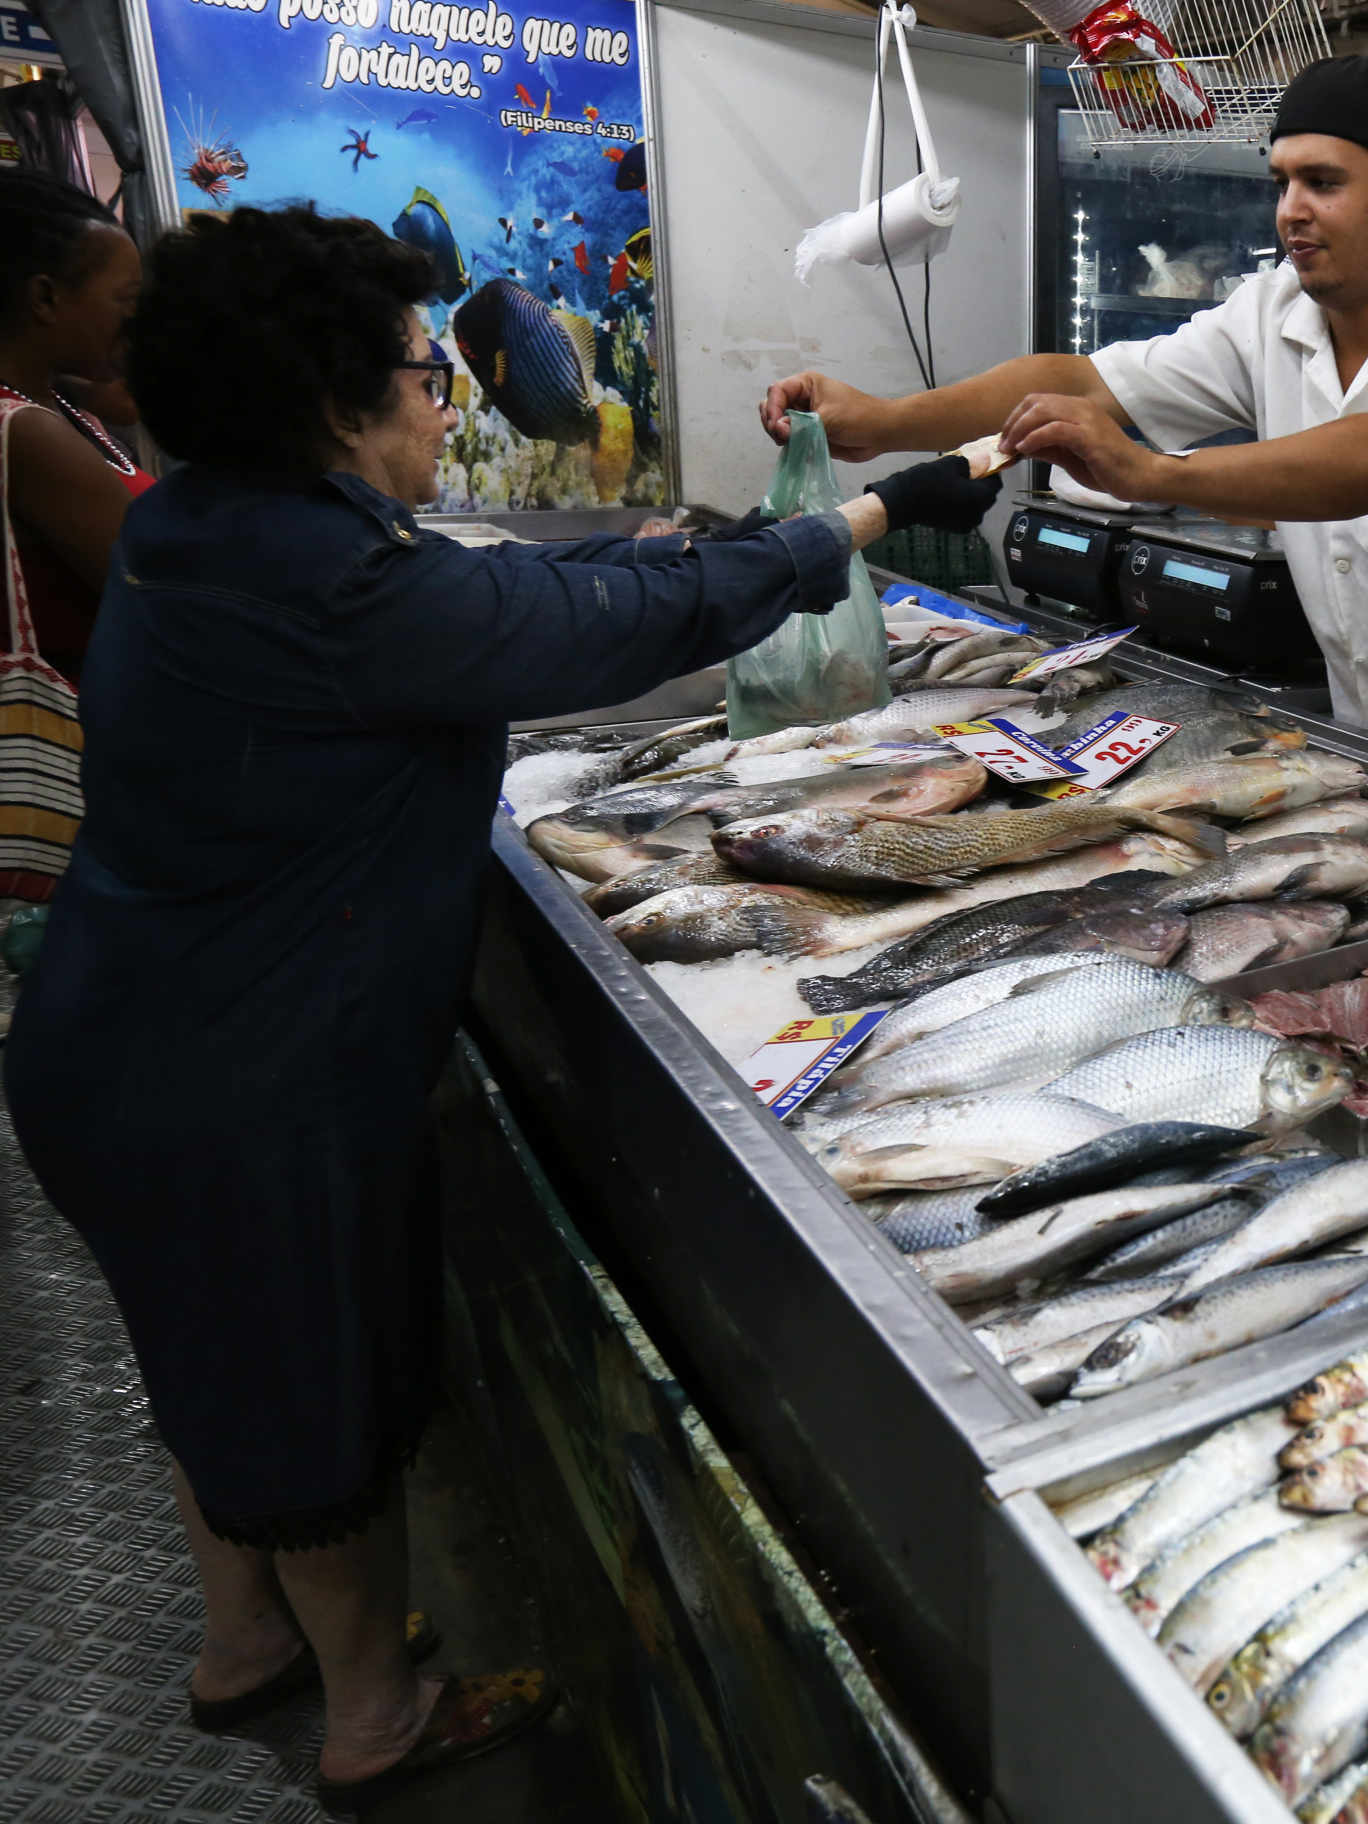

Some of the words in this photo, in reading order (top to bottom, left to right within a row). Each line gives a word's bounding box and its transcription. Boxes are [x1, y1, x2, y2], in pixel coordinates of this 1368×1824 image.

[389, 0, 515, 51] naquele
[522, 17, 578, 64] que
[585, 26, 630, 66] me
[501, 110, 593, 135] (Filipenses
[596, 122, 635, 142] 4:13)
[1260, 579, 1277, 591] prix
[1011, 731, 1064, 762] Corvina
[1152, 725, 1171, 738] KG
[775, 1044, 853, 1108] Tilápia
